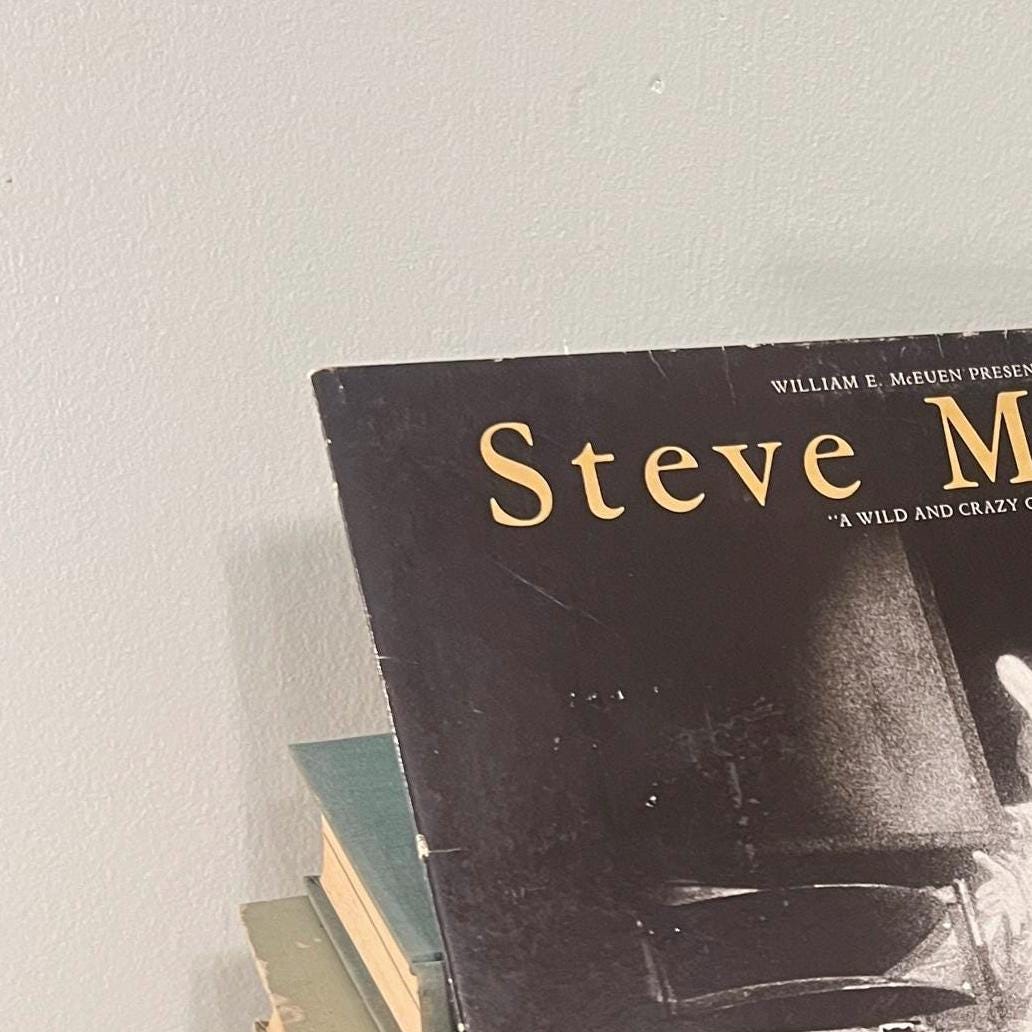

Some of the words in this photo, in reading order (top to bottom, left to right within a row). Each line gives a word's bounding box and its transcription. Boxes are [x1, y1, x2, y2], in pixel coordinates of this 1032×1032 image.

[770, 375, 859, 394] WILLIAM
[866, 373, 884, 388] E.
[889, 367, 963, 387] McEUEN
[478, 421, 862, 528] Steve
[856, 508, 909, 525] WILD
[914, 503, 954, 521] AND
[958, 497, 1018, 516] CRAZY
